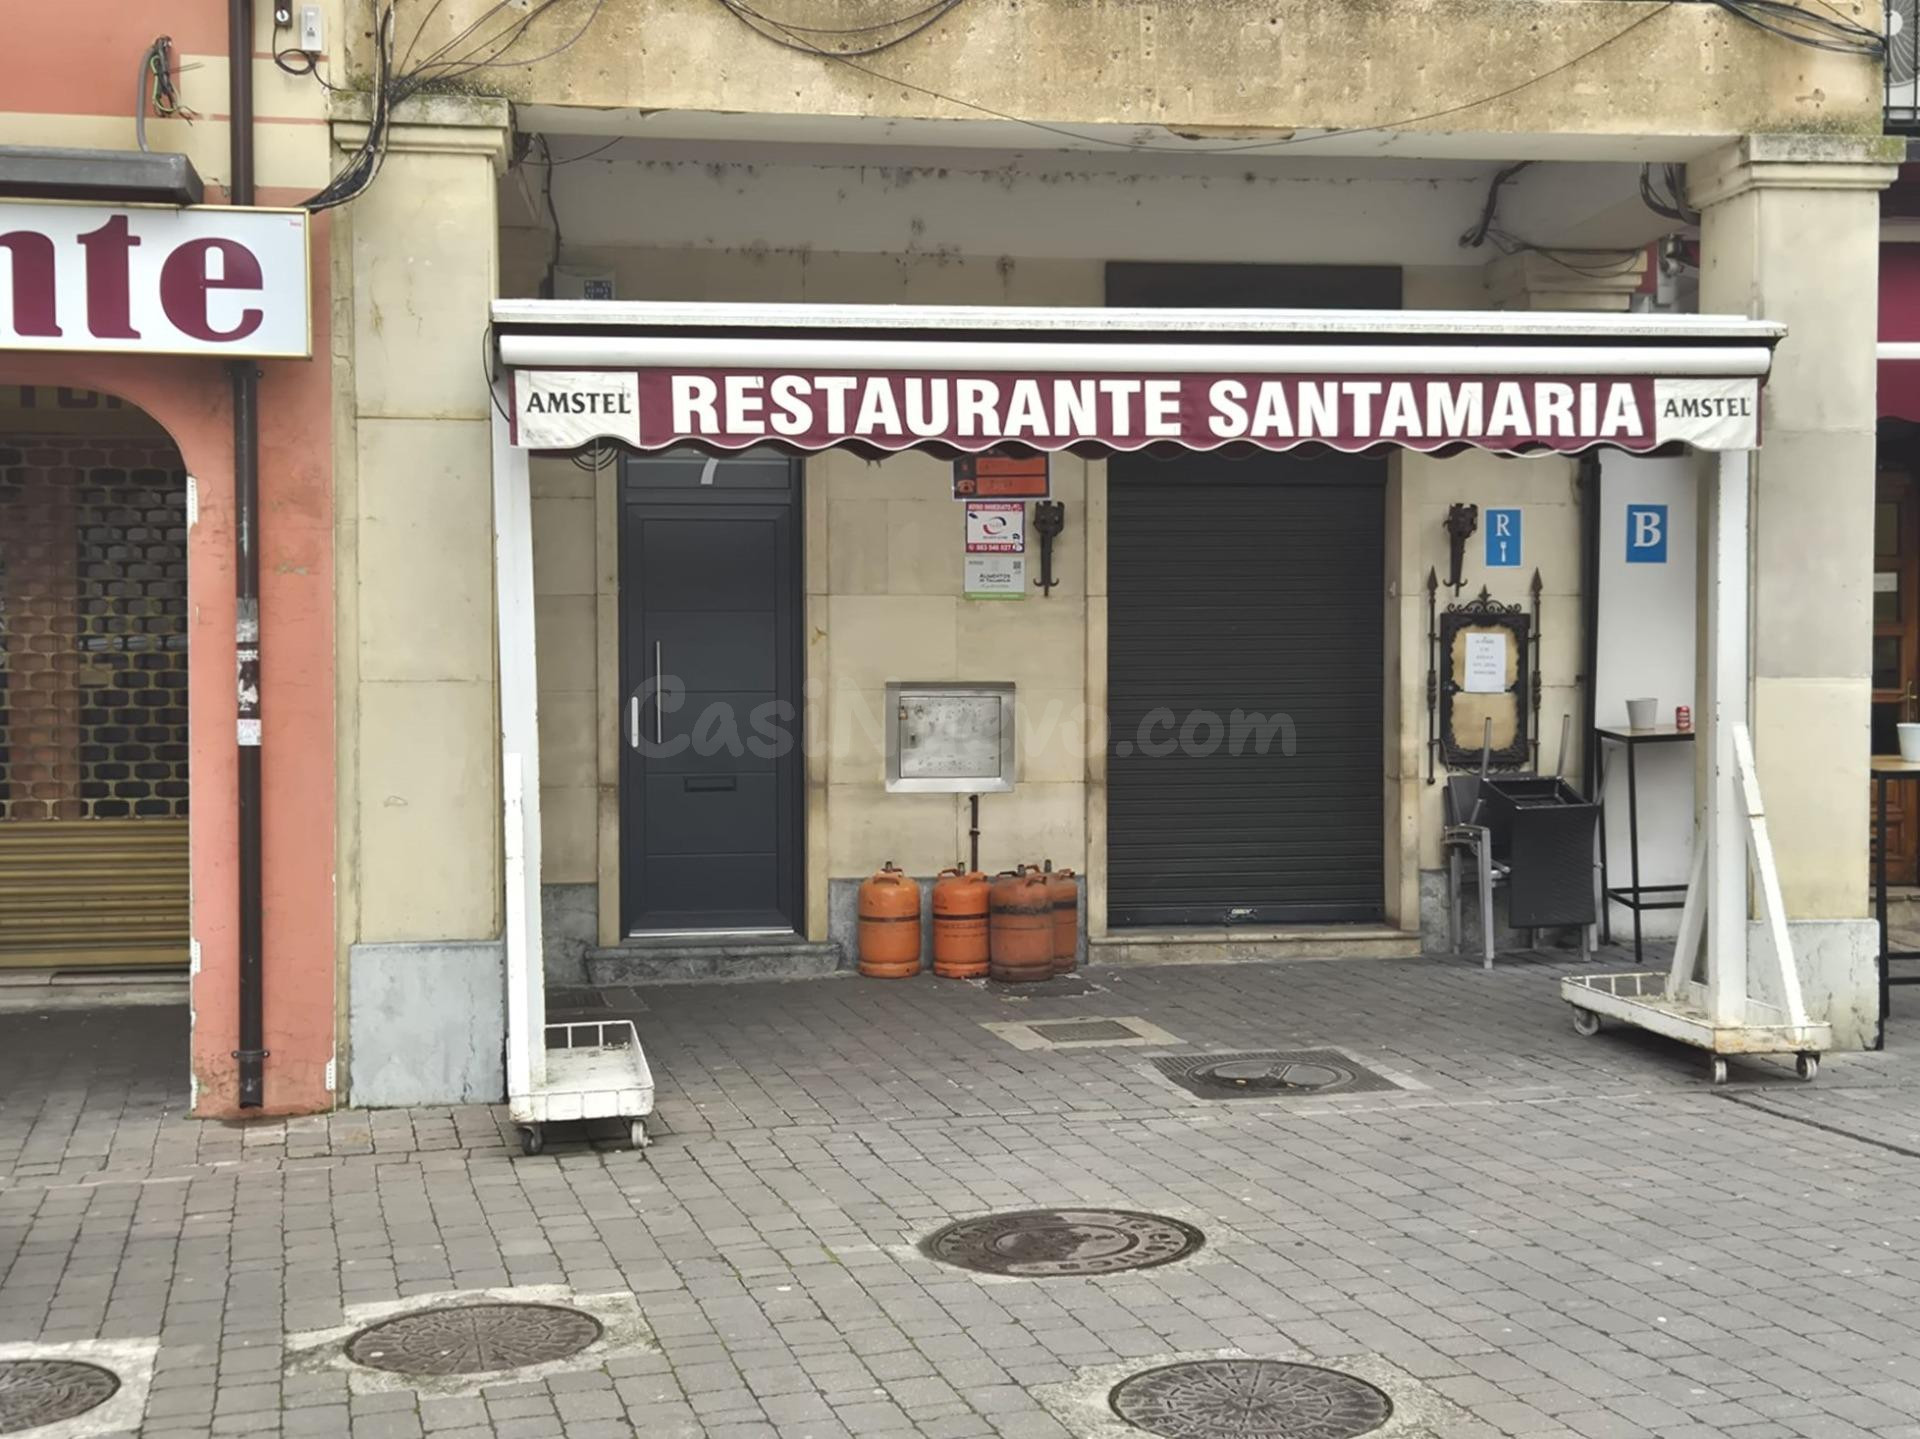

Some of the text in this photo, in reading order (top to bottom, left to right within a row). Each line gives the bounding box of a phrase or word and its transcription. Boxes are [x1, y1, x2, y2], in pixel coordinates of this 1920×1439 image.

[526, 391, 631, 414] AMSTEL
[671, 375, 1643, 438] RESTAURANTE SANTAMARIA
[1663, 397, 1750, 418] AMSTEL
[1496, 513, 1511, 537] R
[1633, 511, 1662, 548] B
